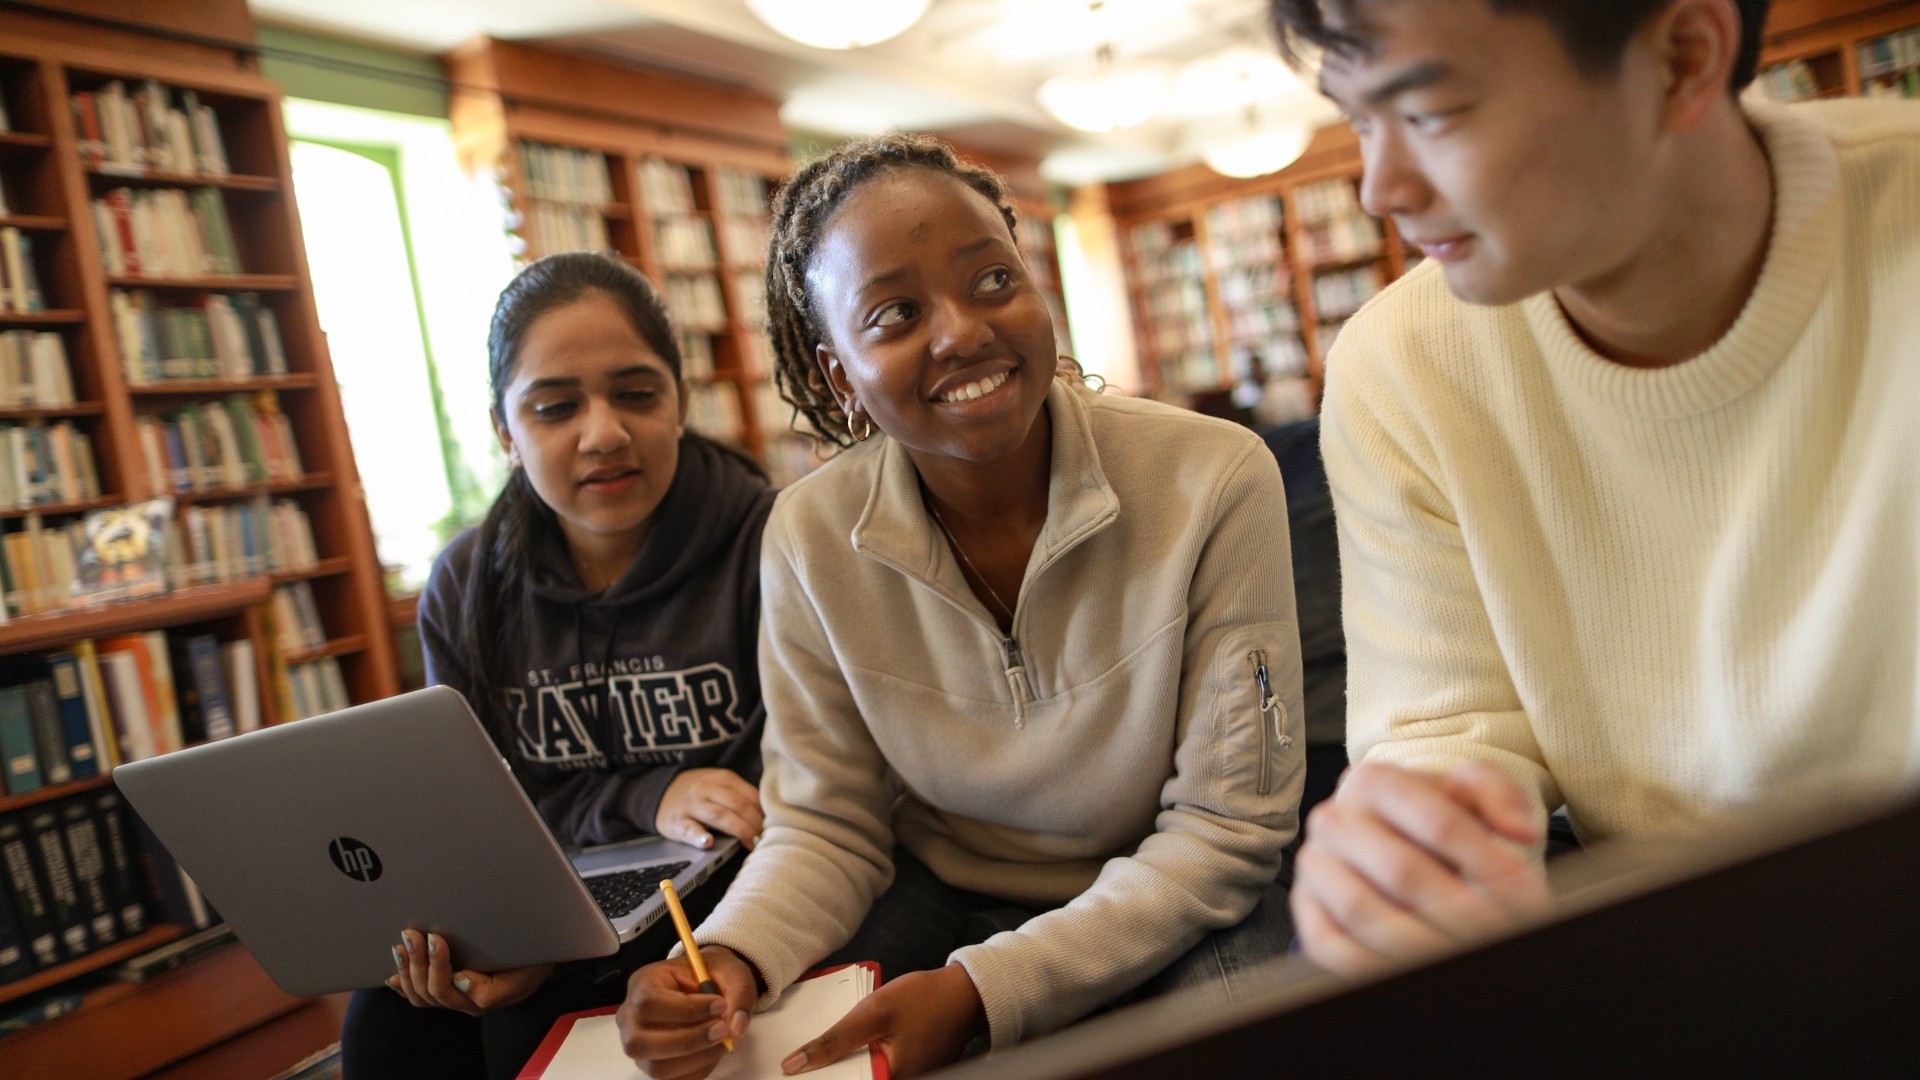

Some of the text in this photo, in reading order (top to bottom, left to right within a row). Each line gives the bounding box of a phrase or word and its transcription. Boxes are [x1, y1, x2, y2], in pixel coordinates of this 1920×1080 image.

[527, 668, 560, 687] ST.
[557, 750, 686, 771] UNIVRSITY
[333, 836, 374, 882] hp
